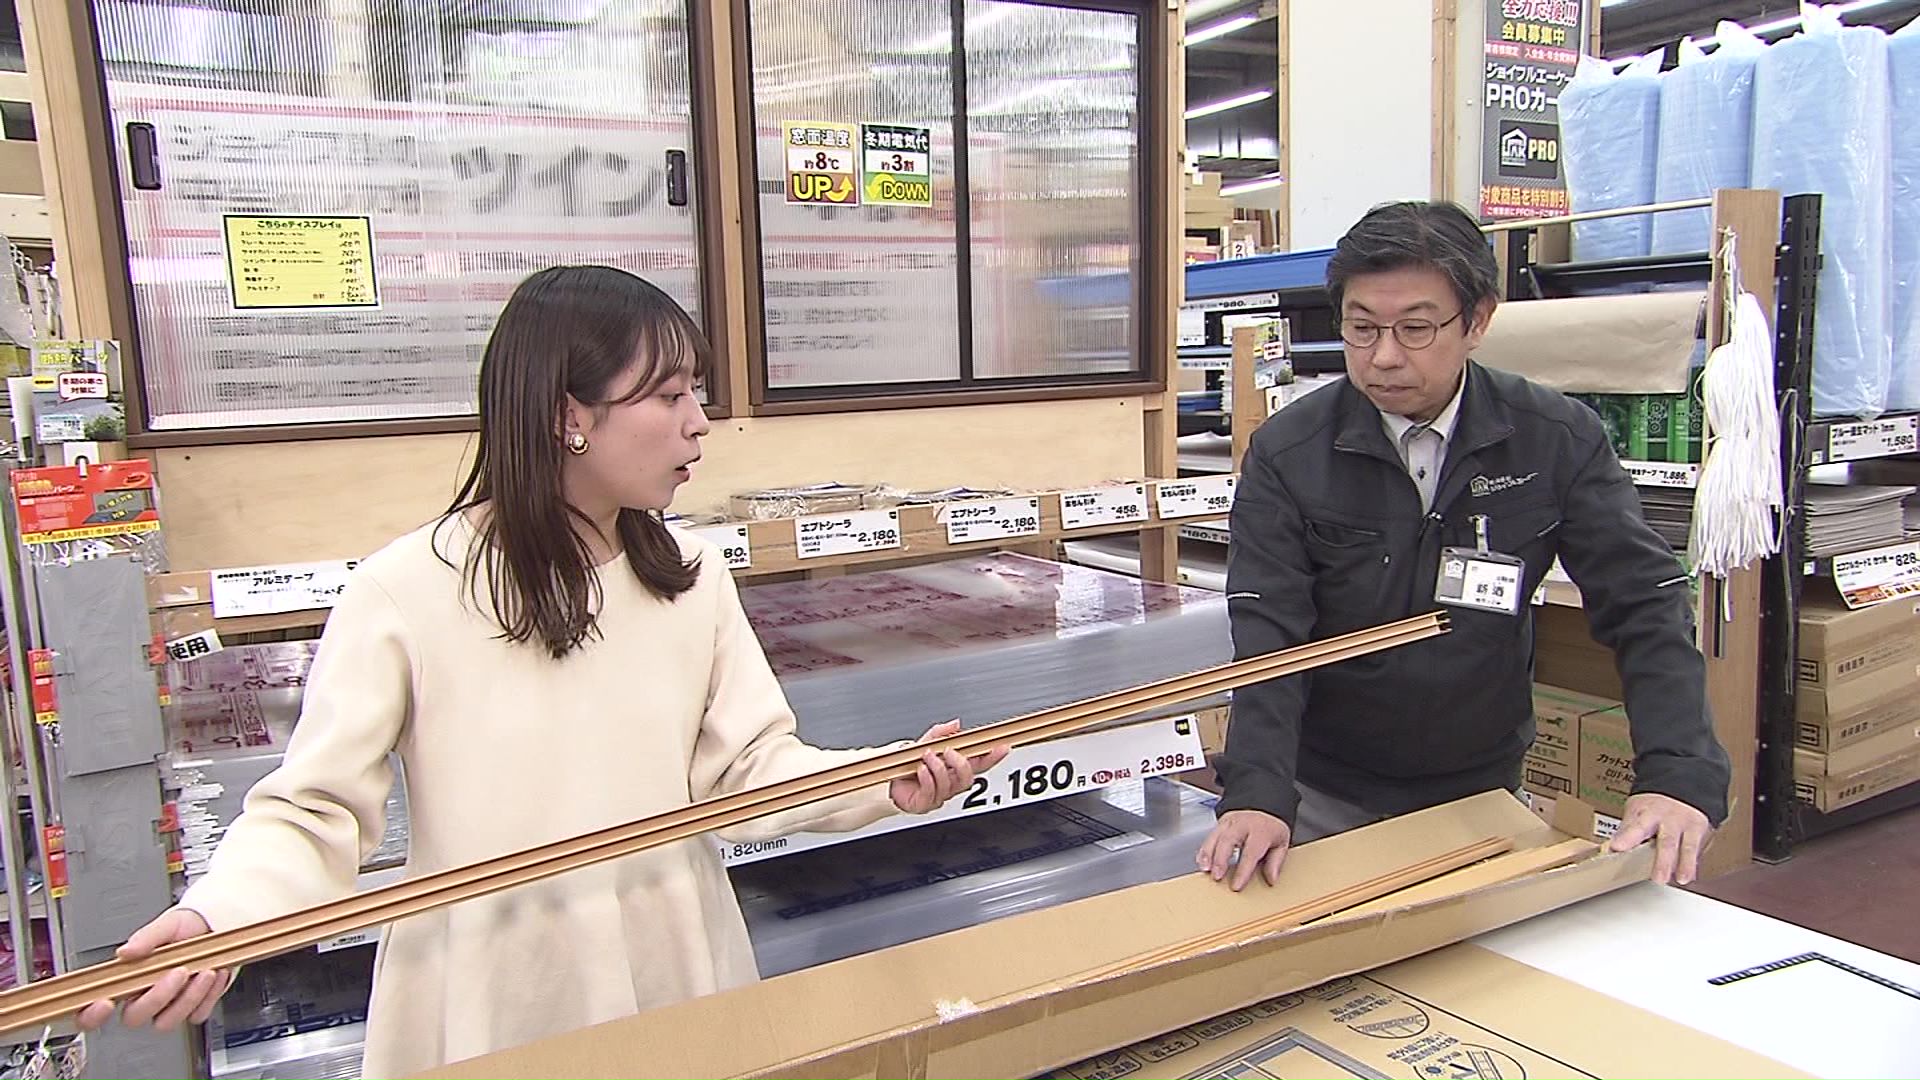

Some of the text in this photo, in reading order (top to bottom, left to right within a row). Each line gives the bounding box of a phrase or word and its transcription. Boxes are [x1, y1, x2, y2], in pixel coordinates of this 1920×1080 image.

[1502, 21, 1565, 45] 会員募集中
[791, 128, 850, 147] 窓面温度
[864, 132, 929, 150] 冬期電気代
[1527, 138, 1557, 161] PRO
[792, 174, 833, 200] UP
[882, 180, 929, 201] DOWN
[167, 636, 210, 660] 使用
